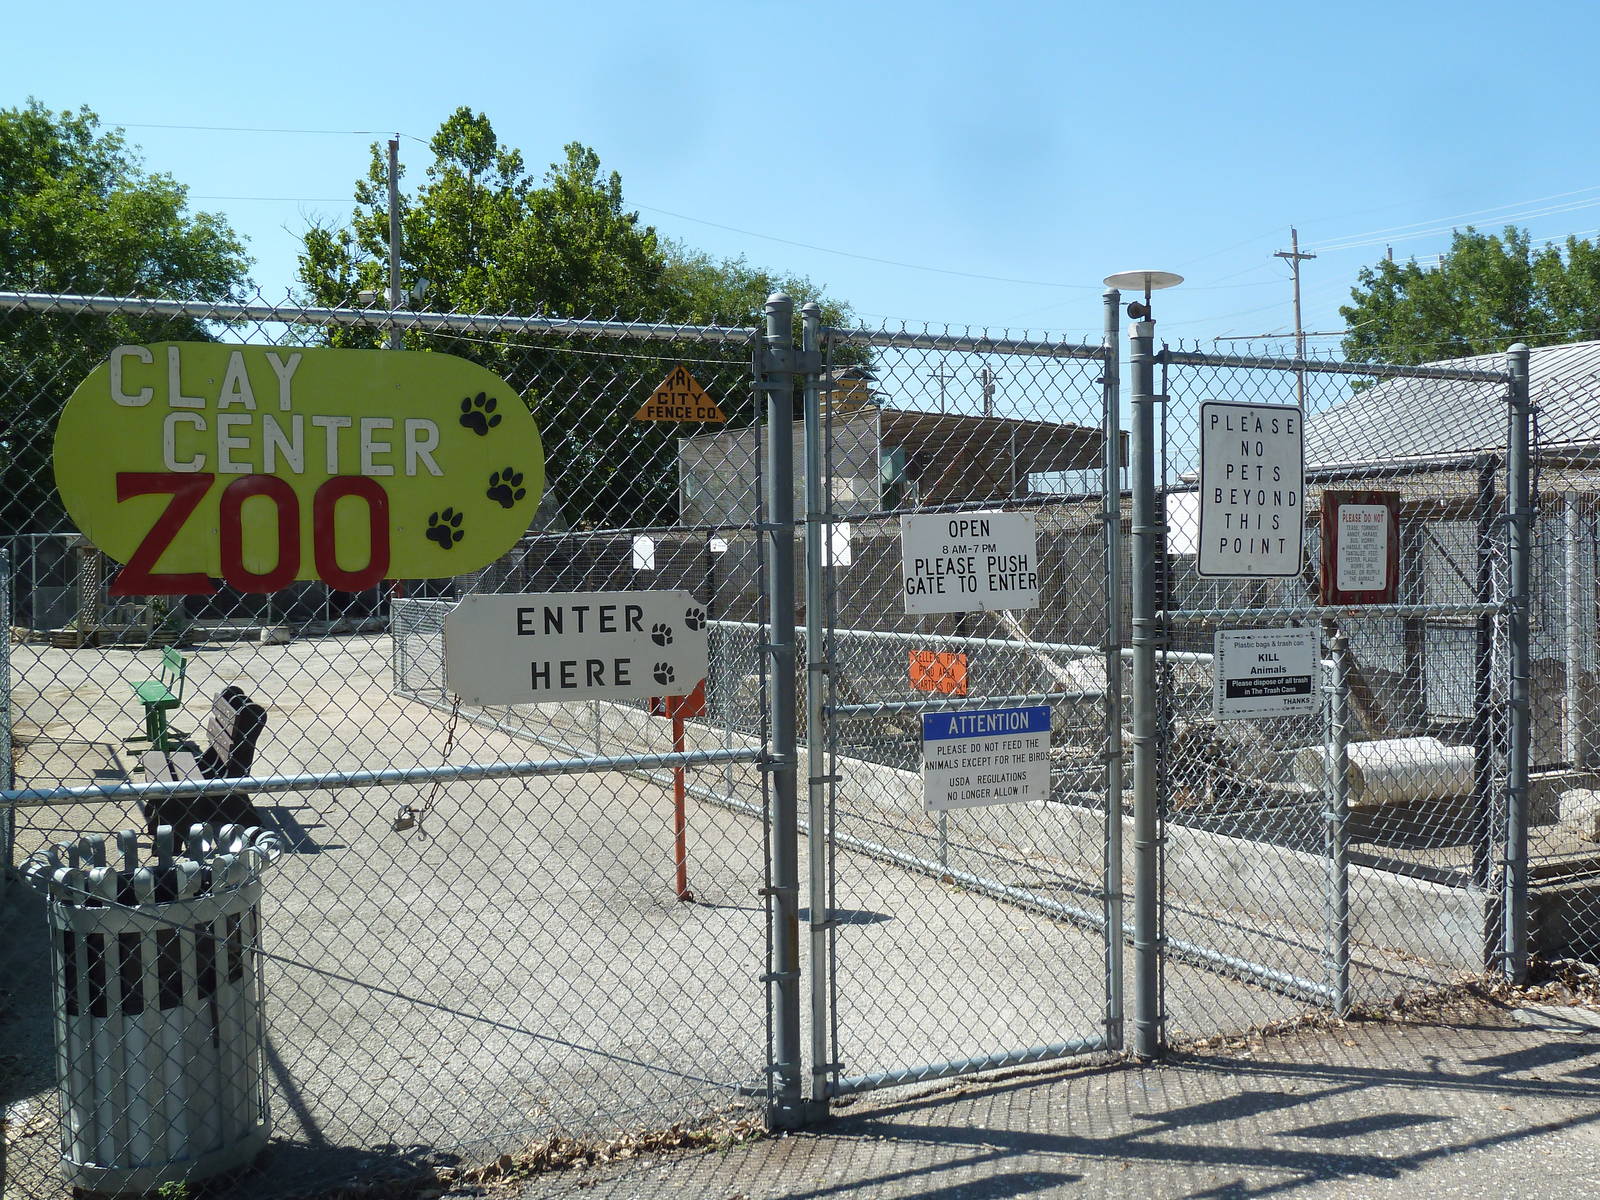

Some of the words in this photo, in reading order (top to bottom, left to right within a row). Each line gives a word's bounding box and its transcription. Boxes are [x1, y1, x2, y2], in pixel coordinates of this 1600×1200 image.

[109, 344, 303, 411] CLAY
[657, 392, 703, 405] CITY
[647, 406, 692, 419] FENCE
[697, 407, 719, 419] CO.
[1211, 414, 1294, 434] PLEASE
[162, 411, 444, 477] CENTER
[1241, 440, 1264, 457] NO
[1226, 464, 1281, 482] PETS
[1214, 488, 1297, 507] BEYOND
[1224, 513, 1280, 530] THIS
[1342, 513, 1362, 523] PLEASE
[1364, 513, 1372, 523] DO
[108, 471, 391, 596] ZOO
[948, 519, 990, 538] OPEN
[942, 545, 949, 554] 8
[982, 543, 997, 553] PM
[1219, 537, 1286, 554] POINT
[915, 556, 977, 577] PLEASE
[987, 554, 1028, 573] PUSH
[906, 576, 946, 595] GATE
[958, 575, 978, 593] TO
[989, 572, 1038, 591] ENTER
[516, 604, 644, 636] ENTER
[1234, 641, 1255, 649] Plastic
[1256, 640, 1270, 648] bags
[1258, 653, 1279, 662] KILL
[530, 658, 632, 690] HERE
[1250, 665, 1287, 675] Animals
[1253, 678, 1277, 688] dispose
[1283, 697, 1310, 705] THANKS
[948, 711, 1029, 735] ATTENTION
[937, 743, 967, 756] PLEASE
[971, 743, 981, 753] DO
[984, 742, 999, 752] NOT
[1002, 740, 1022, 750] FEED
[1026, 738, 1040, 748] THE
[924, 759, 959, 771] ANIMALS
[962, 756, 991, 768] EXCEPT
[994, 755, 1010, 765] FOR
[1012, 753, 1026, 764] THE
[1028, 751, 1050, 762] BIRDS
[949, 776, 971, 787] USDA
[977, 771, 1027, 785] REGULATIONS
[947, 791, 958, 801] NO
[961, 788, 991, 800] LONGER
[993, 786, 1019, 797] ALLOW
[1022, 785, 1030, 794] IT
